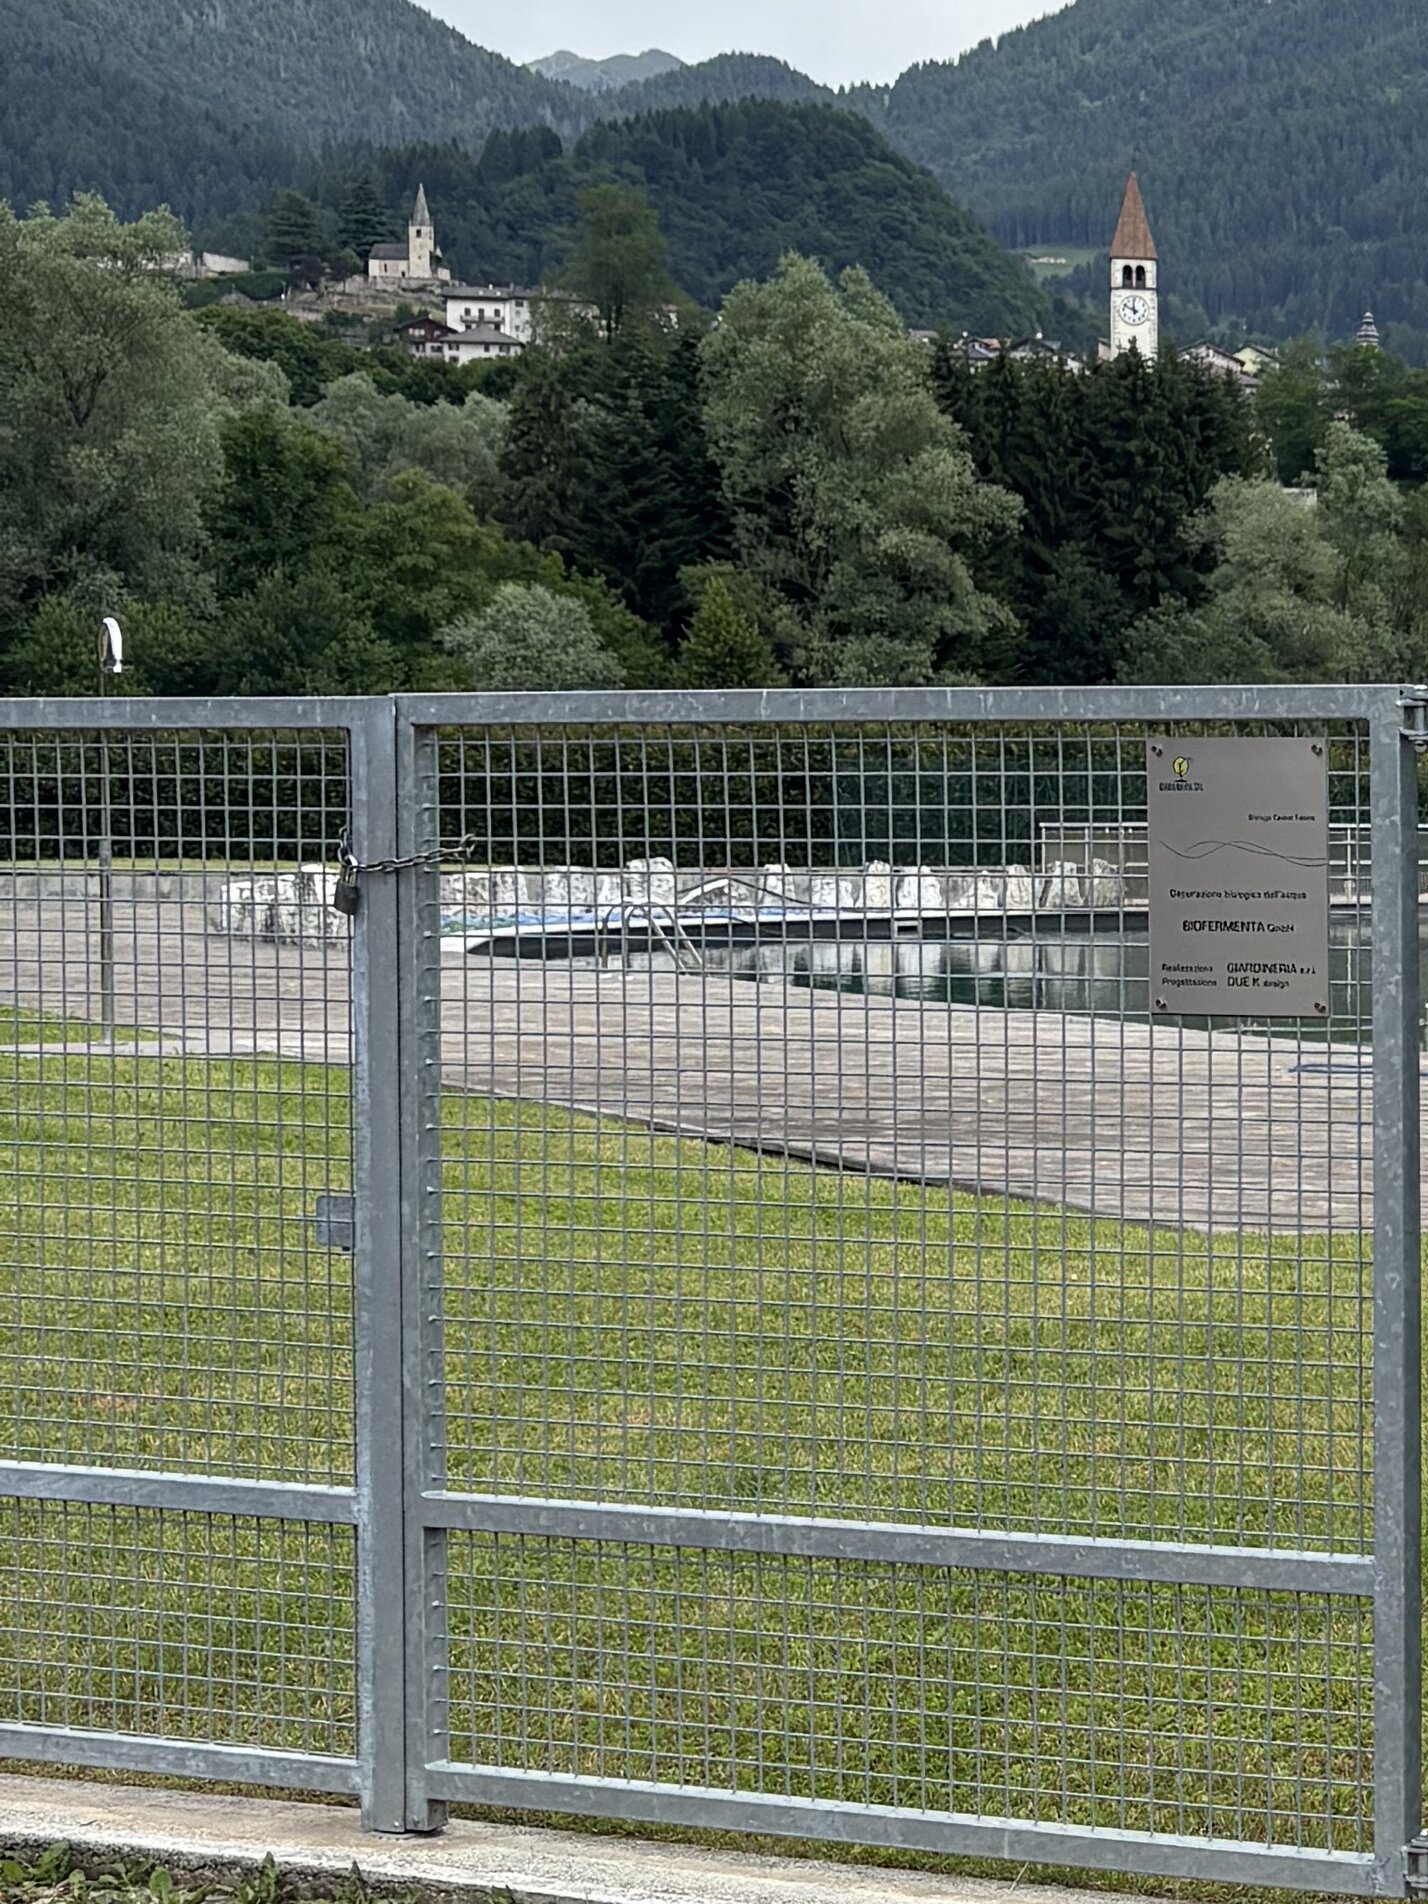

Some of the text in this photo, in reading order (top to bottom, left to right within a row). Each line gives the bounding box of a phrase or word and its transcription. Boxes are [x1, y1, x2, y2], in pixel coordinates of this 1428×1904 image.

[1182, 920, 1265, 933] BIOFERMENTA
[1161, 977, 1217, 988] Progettazione
[1227, 976, 1250, 987] DUE
